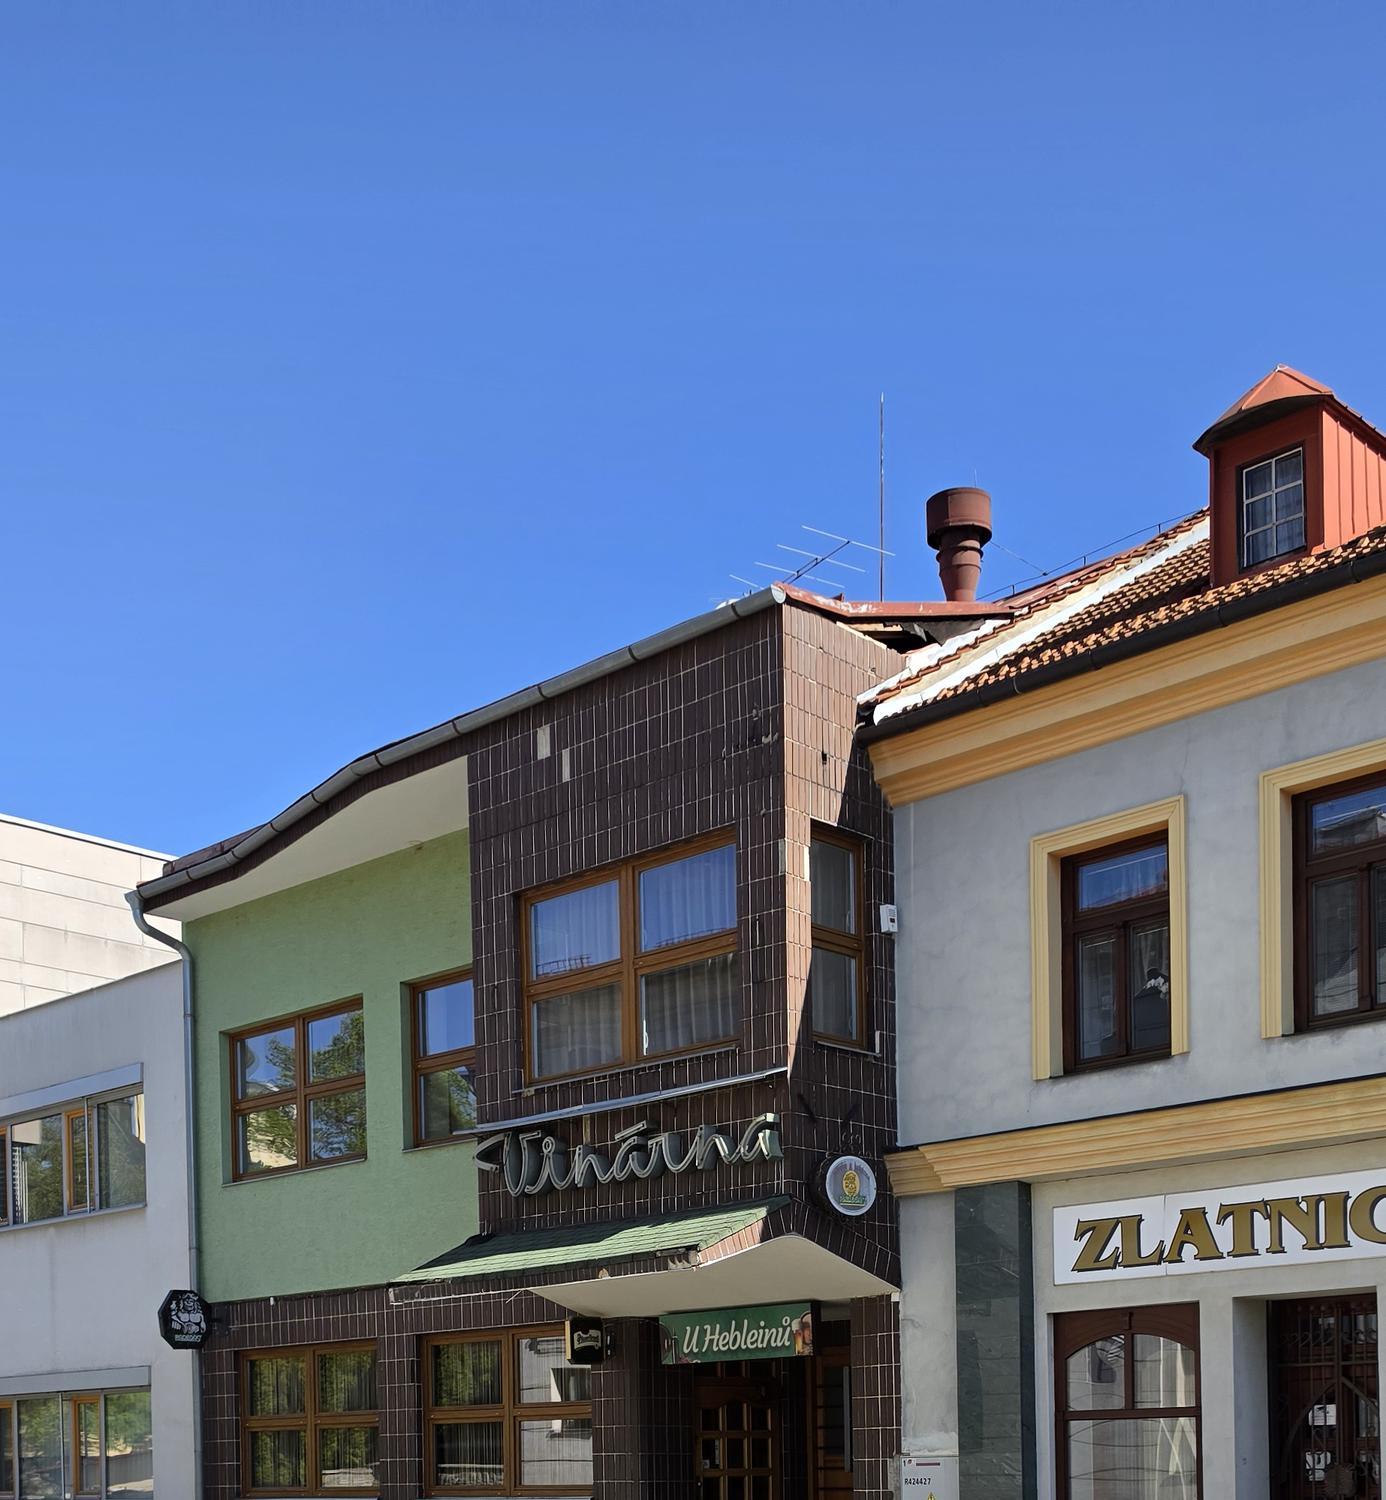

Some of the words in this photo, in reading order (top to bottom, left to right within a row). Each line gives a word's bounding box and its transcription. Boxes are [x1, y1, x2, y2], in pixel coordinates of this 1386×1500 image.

[473, 1112, 783, 1197] Vinárna
[683, 1326, 699, 1353] U
[702, 1316, 791, 1352] Hebleinů
